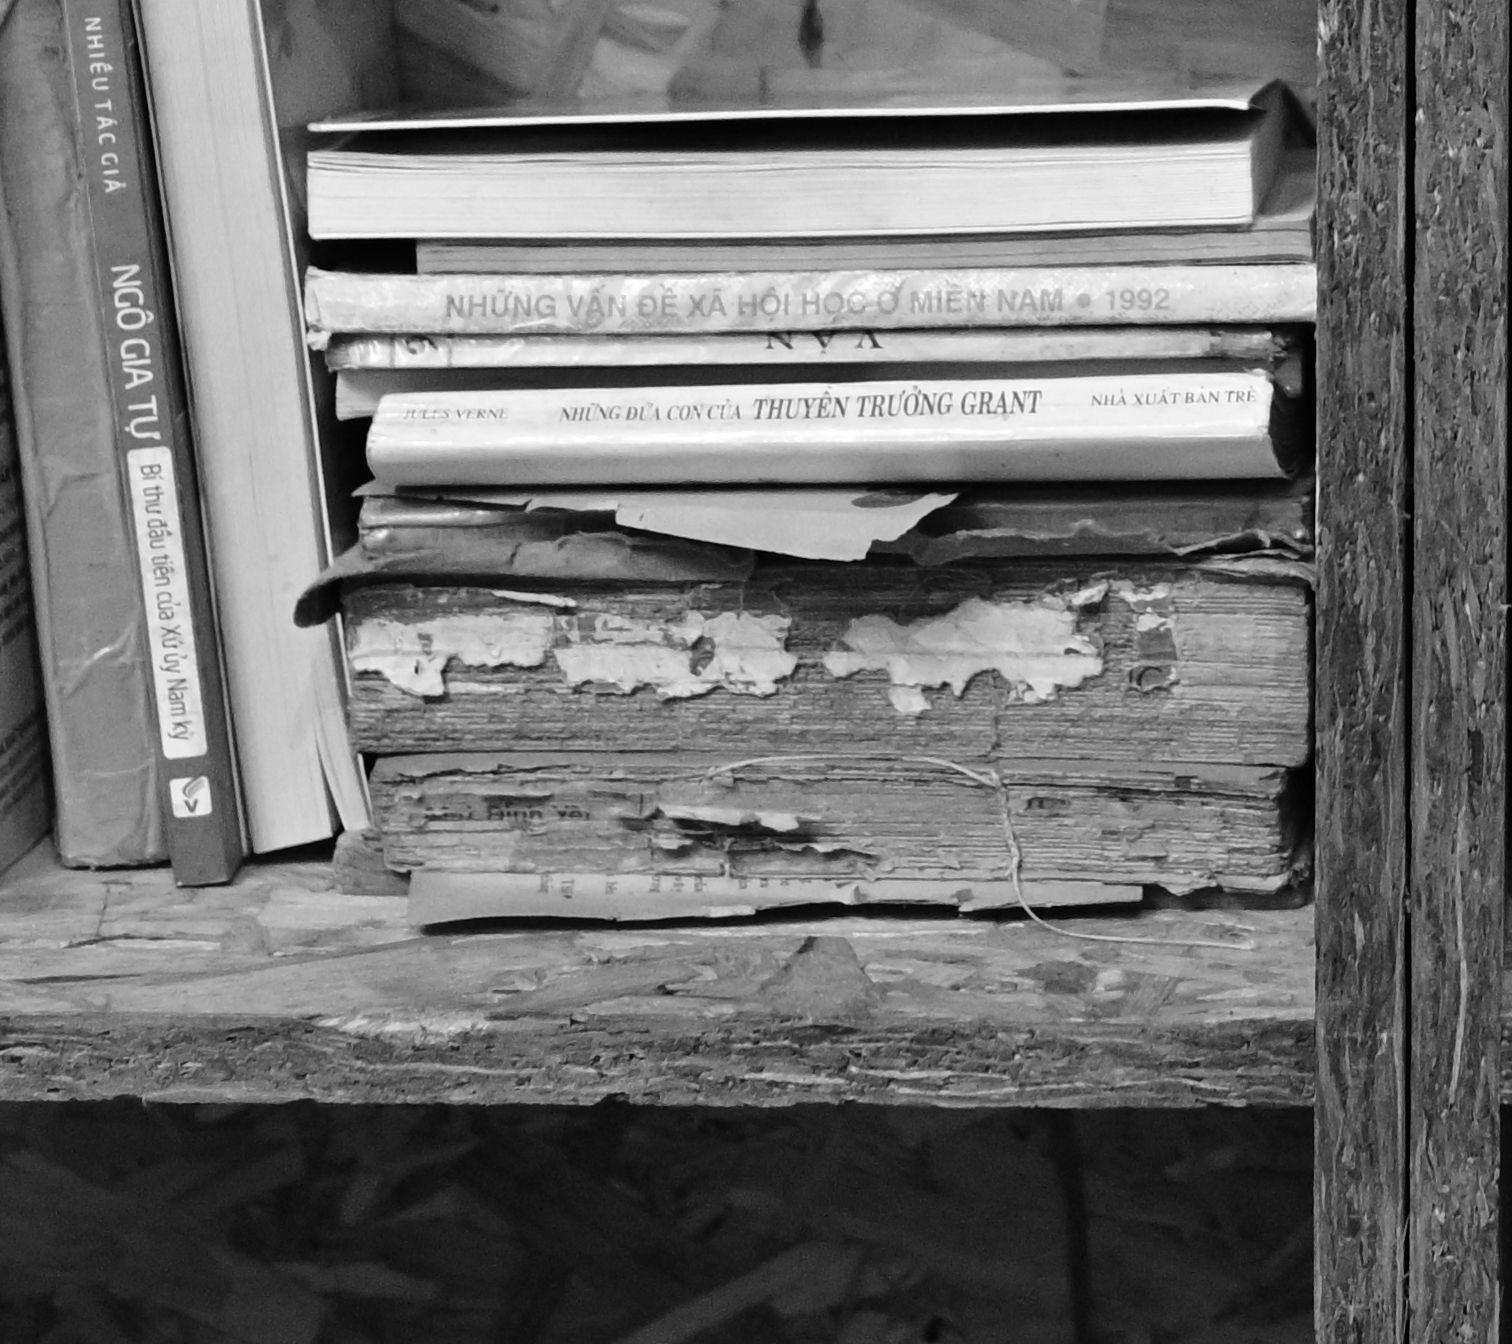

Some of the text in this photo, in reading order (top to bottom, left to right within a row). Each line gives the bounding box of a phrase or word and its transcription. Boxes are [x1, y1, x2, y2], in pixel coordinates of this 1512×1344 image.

[111, 264, 161, 440] NGÔ GIA TỰ
[667, 405, 710, 420] CON
[753, 391, 850, 420] THUYỀN
[857, 385, 953, 418] TRƯỞNG
[961, 390, 1042, 415] GRANT
[143, 485, 164, 515] thư
[147, 518, 173, 550] đầu
[151, 553, 175, 587] tiên
[156, 591, 182, 621] của
[160, 625, 184, 649] Xứ
[167, 678, 188, 717] Nam
